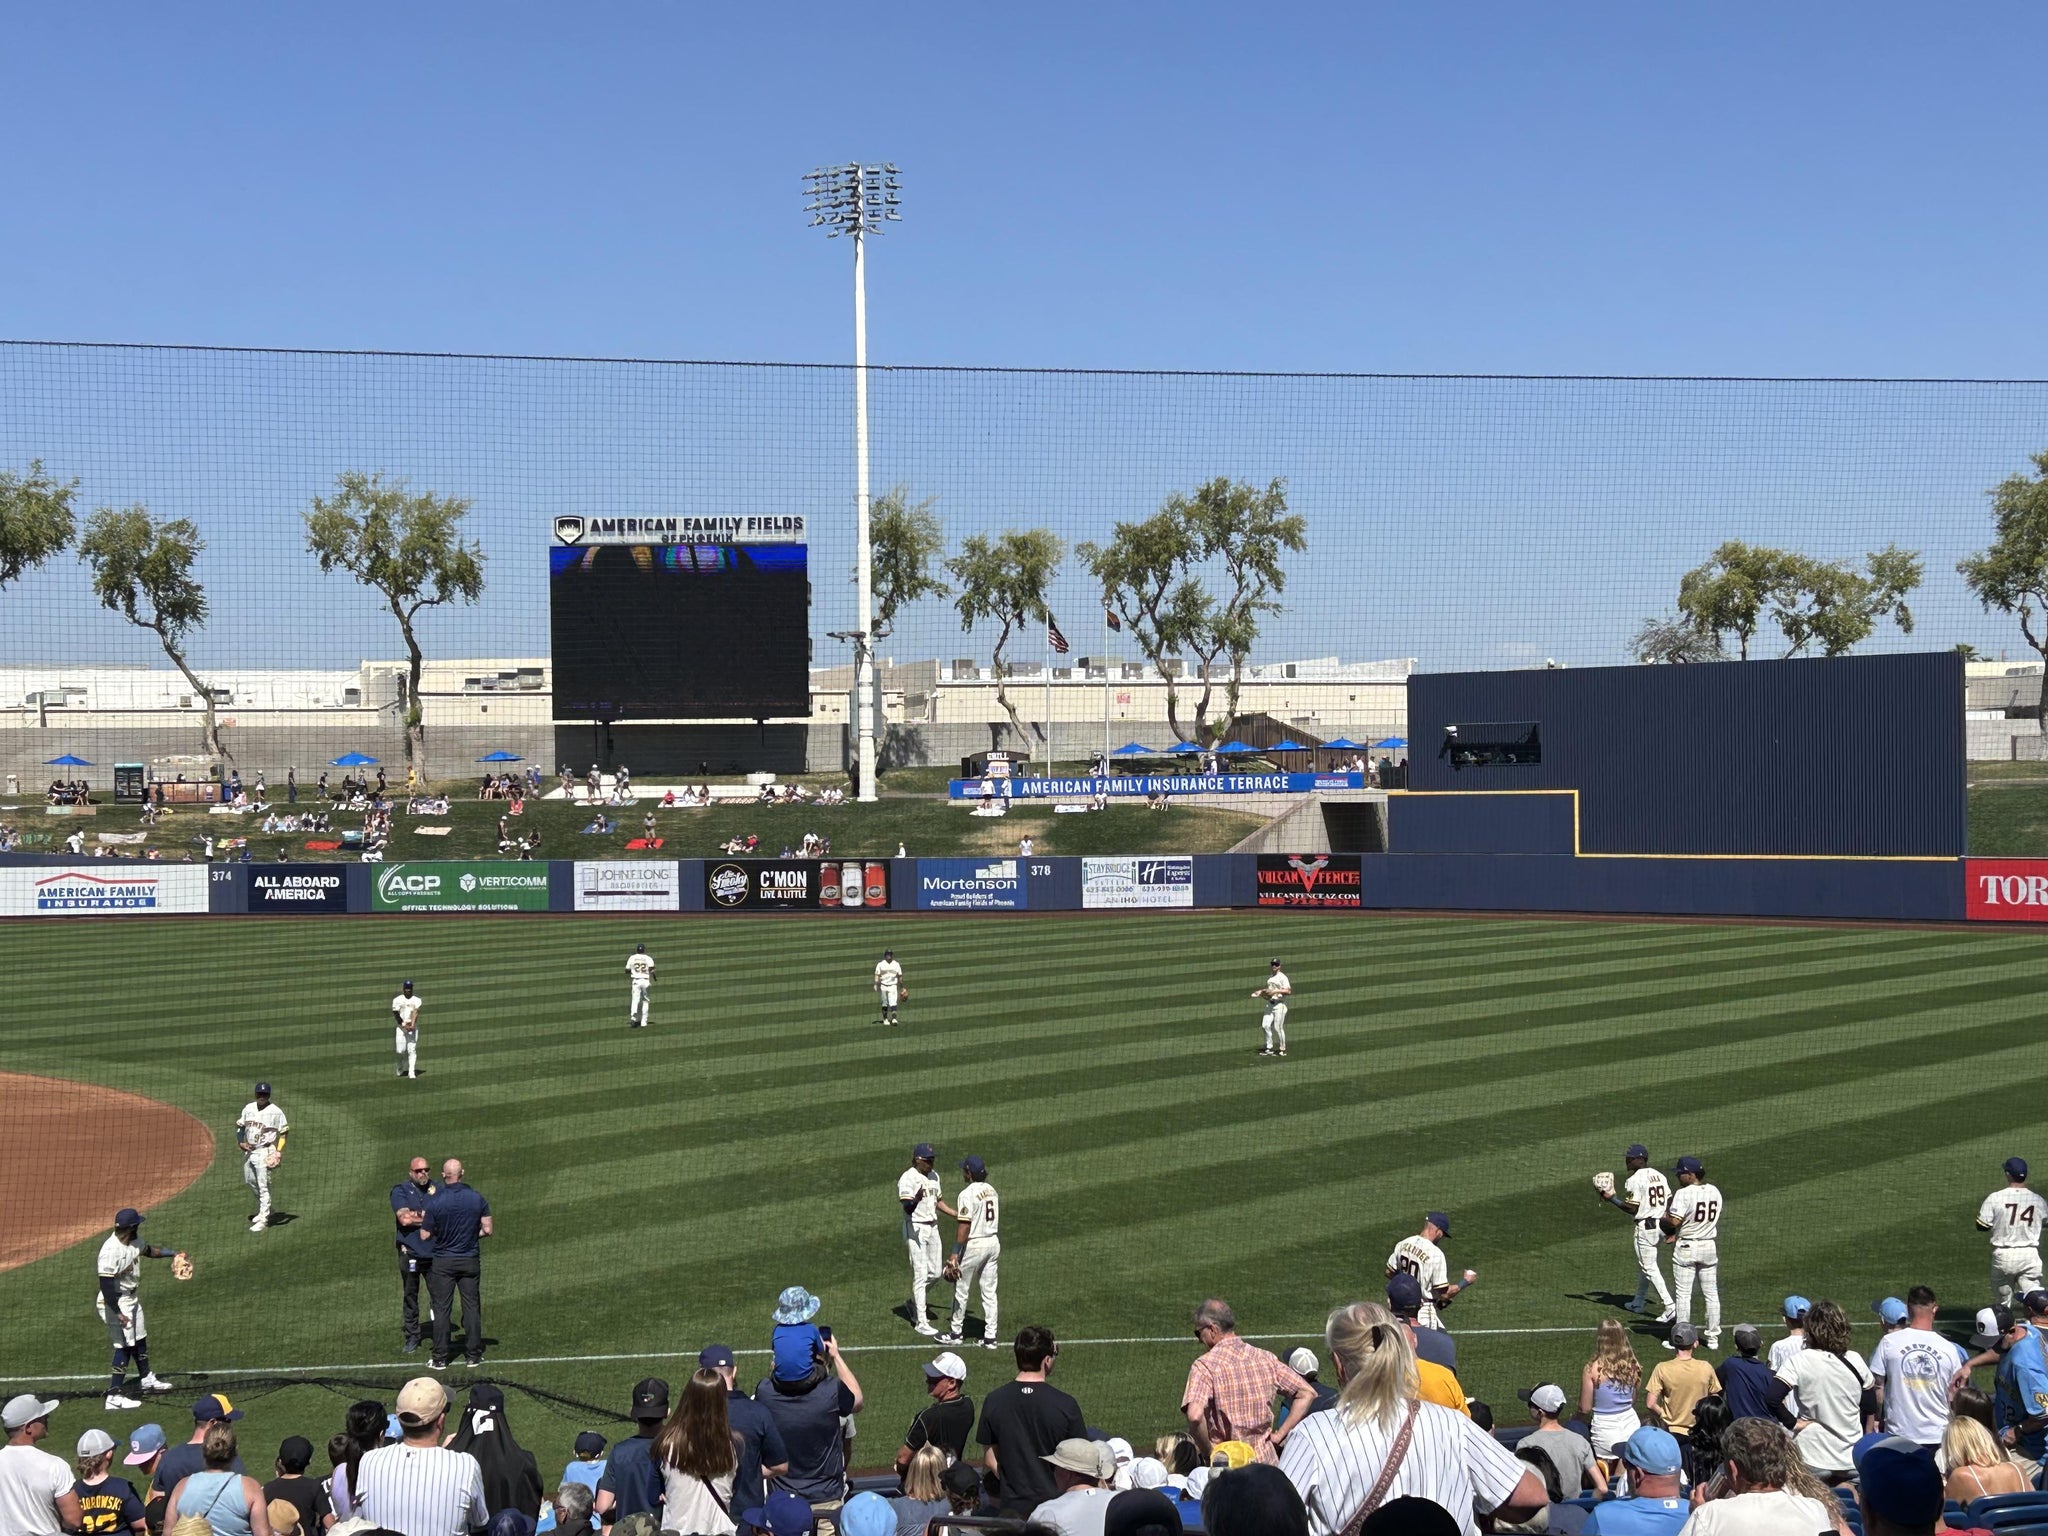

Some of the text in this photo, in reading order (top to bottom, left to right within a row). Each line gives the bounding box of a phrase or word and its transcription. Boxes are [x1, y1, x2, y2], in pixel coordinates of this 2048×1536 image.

[590, 516, 804, 532] AMERICAN FAMILY FIELDS
[1021, 776, 1289, 794] AMERICAN FAMILY INSURANCE TERRACE
[600, 869, 629, 880] JOHN
[640, 869, 670, 880] LONG
[1030, 865, 1051, 876] 378
[1088, 863, 1131, 874] STAYBRIDGE
[211, 870, 232, 881] 374
[478, 876, 547, 887] VERTICOMM
[760, 871, 807, 887] C'MON
[1257, 871, 1299, 884] VULCAN
[1319, 871, 1353, 885] FENCE
[254, 876, 340, 888] ALL ABOARD
[387, 875, 441, 891] ACP
[923, 877, 1017, 890] Mortenson
[38, 886, 156, 898] AMERICAN FAMILY
[264, 888, 326, 900] AMERICA
[760, 890, 807, 899] LIVE A LITTLE
[46, 898, 147, 908] INSURANCE
[1648, 1185, 1666, 1207] 89
[985, 1200, 996, 1222] 6
[1694, 1200, 1718, 1223] 66
[2004, 1203, 2035, 1228] 74
